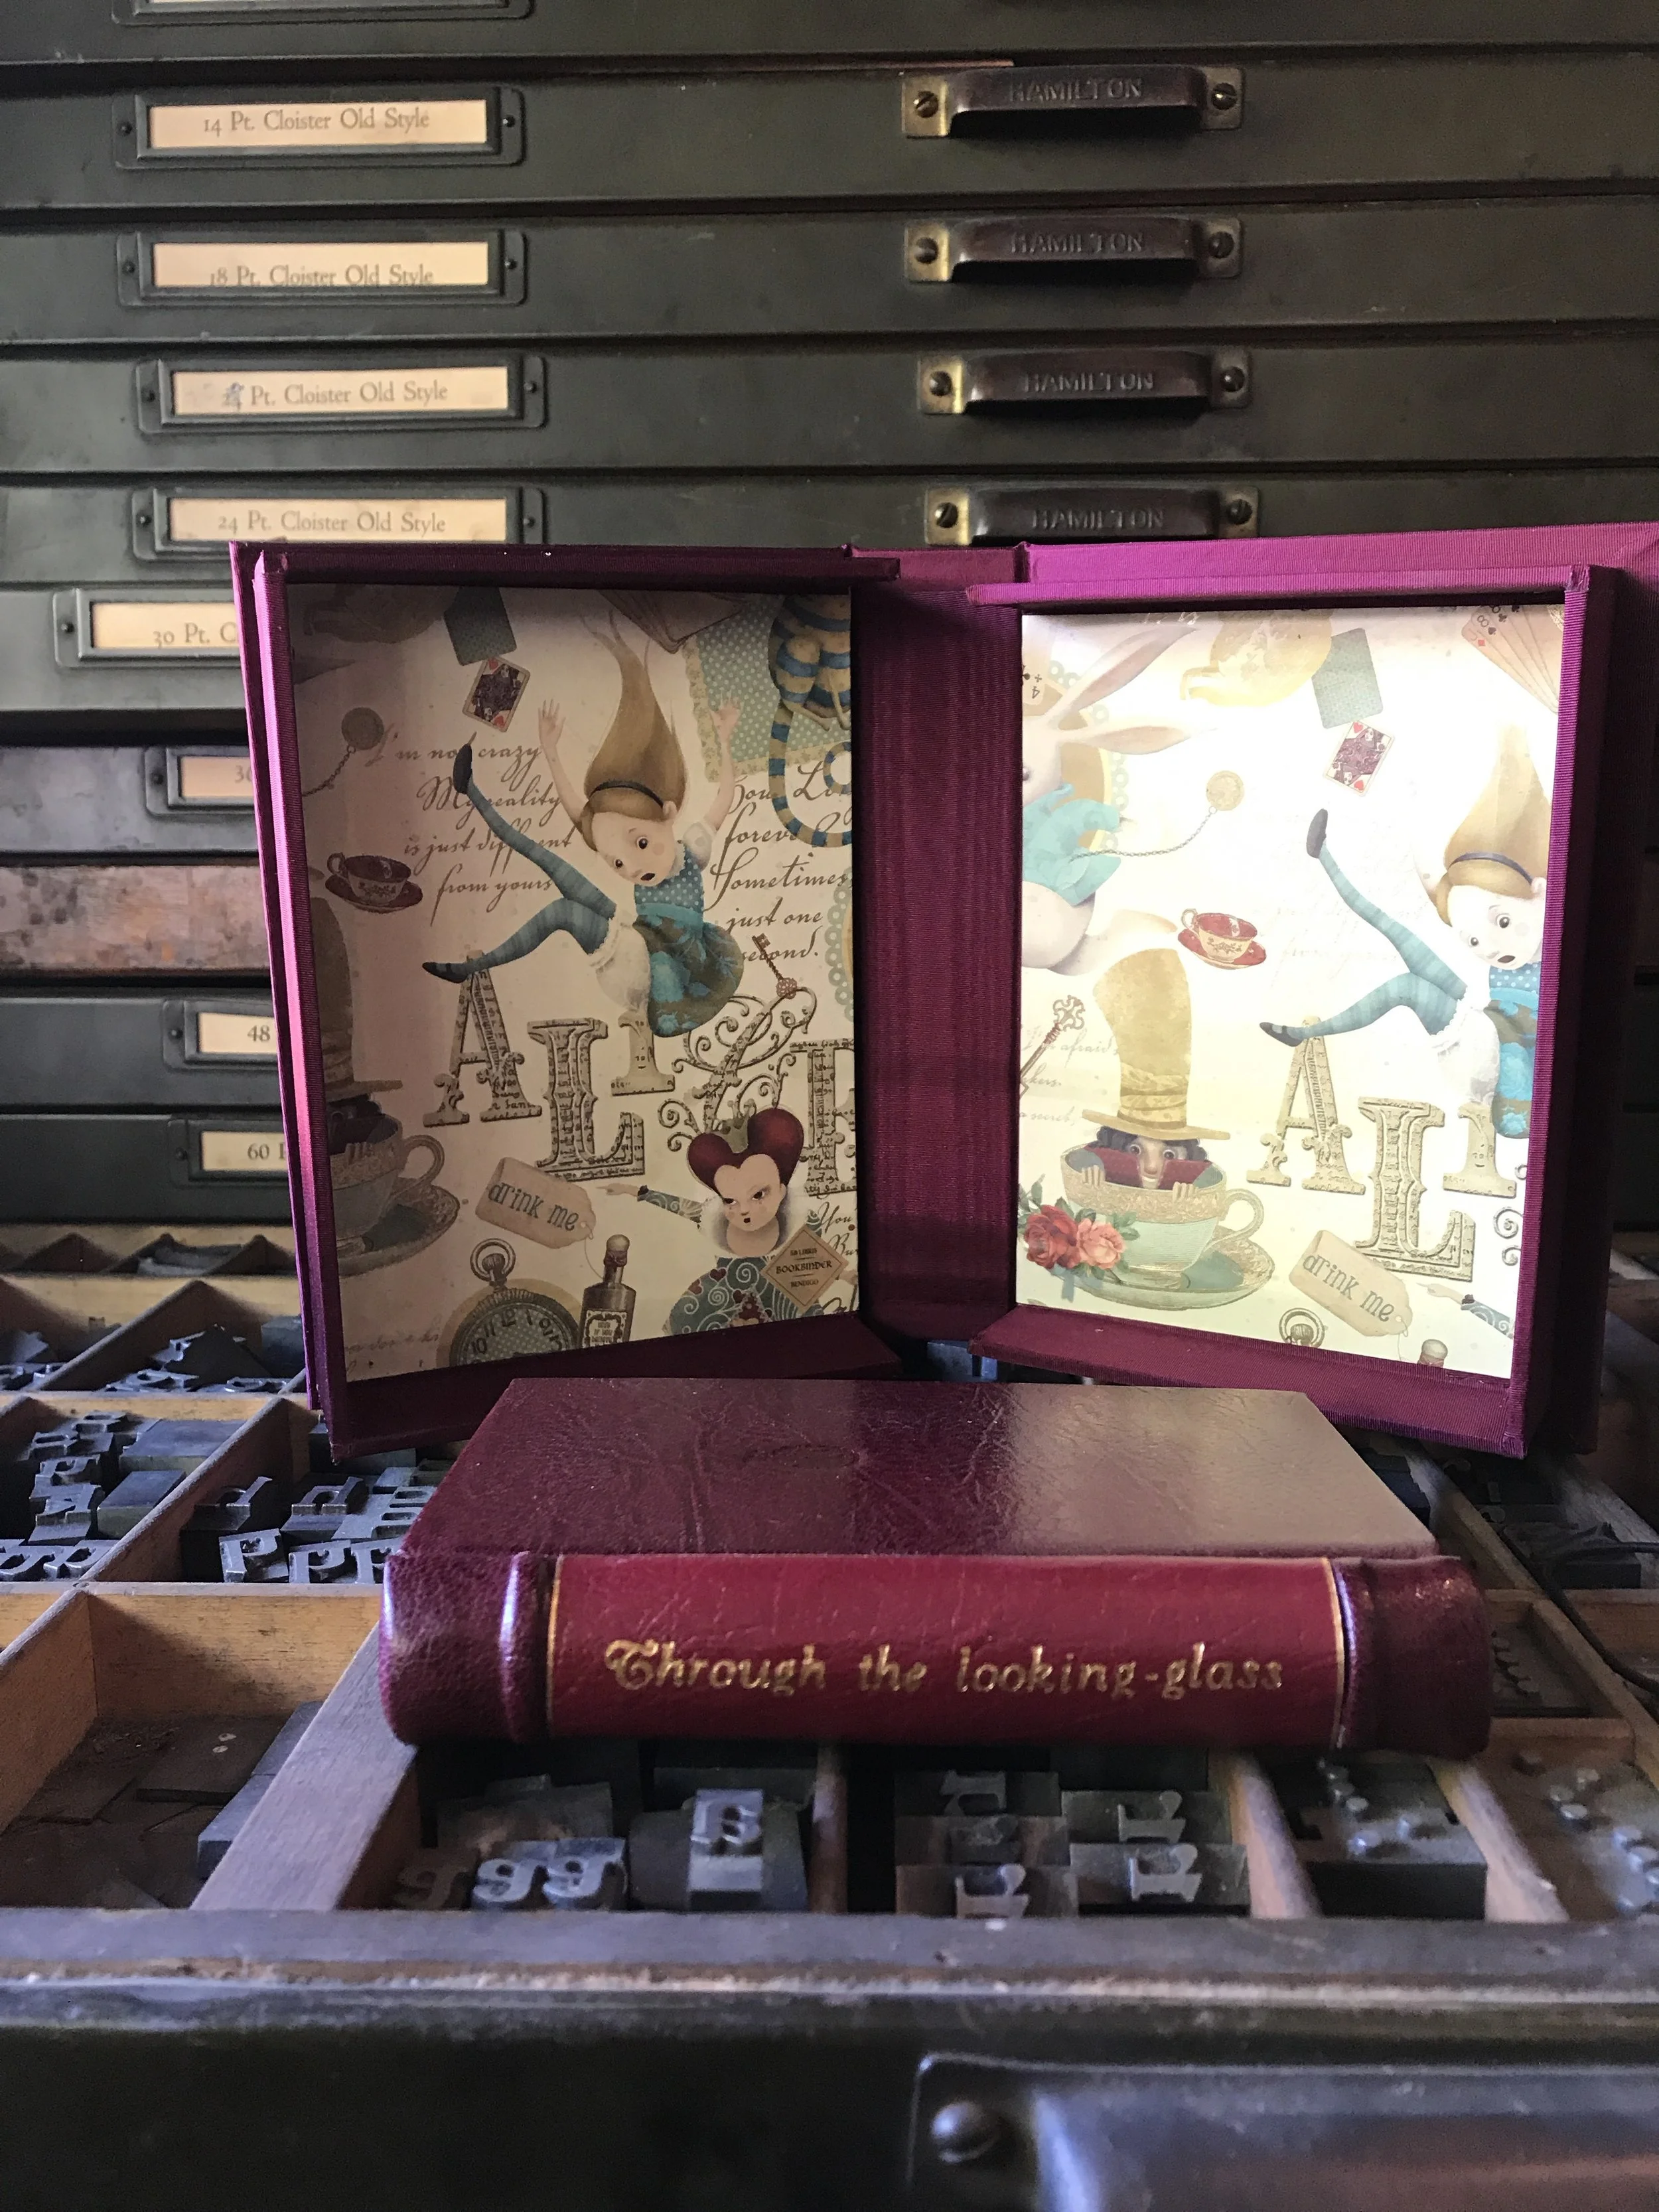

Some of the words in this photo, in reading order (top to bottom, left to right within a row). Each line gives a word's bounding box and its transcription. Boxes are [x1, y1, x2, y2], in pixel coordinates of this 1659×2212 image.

[1009, 78, 1143, 102] HAMILTON
[203, 118, 222, 137] 14
[231, 110, 255, 132] Pt.
[264, 108, 331, 131] Cloister
[340, 106, 376, 129] Old
[385, 107, 430, 135] Style
[1010, 232, 1145, 255] HAMILTON
[210, 268, 228, 286] 18
[237, 266, 260, 285] Pt.
[270, 265, 336, 285] Cloister
[345, 264, 382, 285] Old
[389, 264, 433, 285] Style
[250, 385, 275, 407] Pt.
[284, 383, 351, 405] Cloister
[360, 381, 395, 402] Old
[403, 380, 448, 407] Style
[1023, 371, 1155, 393] HAMILTON
[218, 516, 238, 536] 24
[248, 510, 271, 531] Pt.
[281, 510, 348, 531] Cloister
[357, 510, 392, 532] Old
[401, 511, 446, 536] Style
[1032, 508, 1165, 530] HAMILTON
[153, 630, 175, 649] 30
[184, 623, 210, 644] Pt.
[478, 745, 543, 792] crazy
[413, 827, 476, 877] just
[430, 863, 489, 928] from
[727, 897, 783, 931] just
[784, 913, 824, 926] one
[248, 1024, 271, 1043] 48
[248, 1143, 270, 1160] 60
[488, 1182, 545, 1220] drink
[547, 1203, 580, 1232] me
[776, 1260, 832, 1274] BOOKBINDER
[1303, 1252, 1360, 1301] drink
[1360, 1291, 1396, 1323] me
[605, 1639, 827, 1697] Through
[859, 1644, 927, 1696] the
[956, 1641, 1283, 1701] looking-glass
